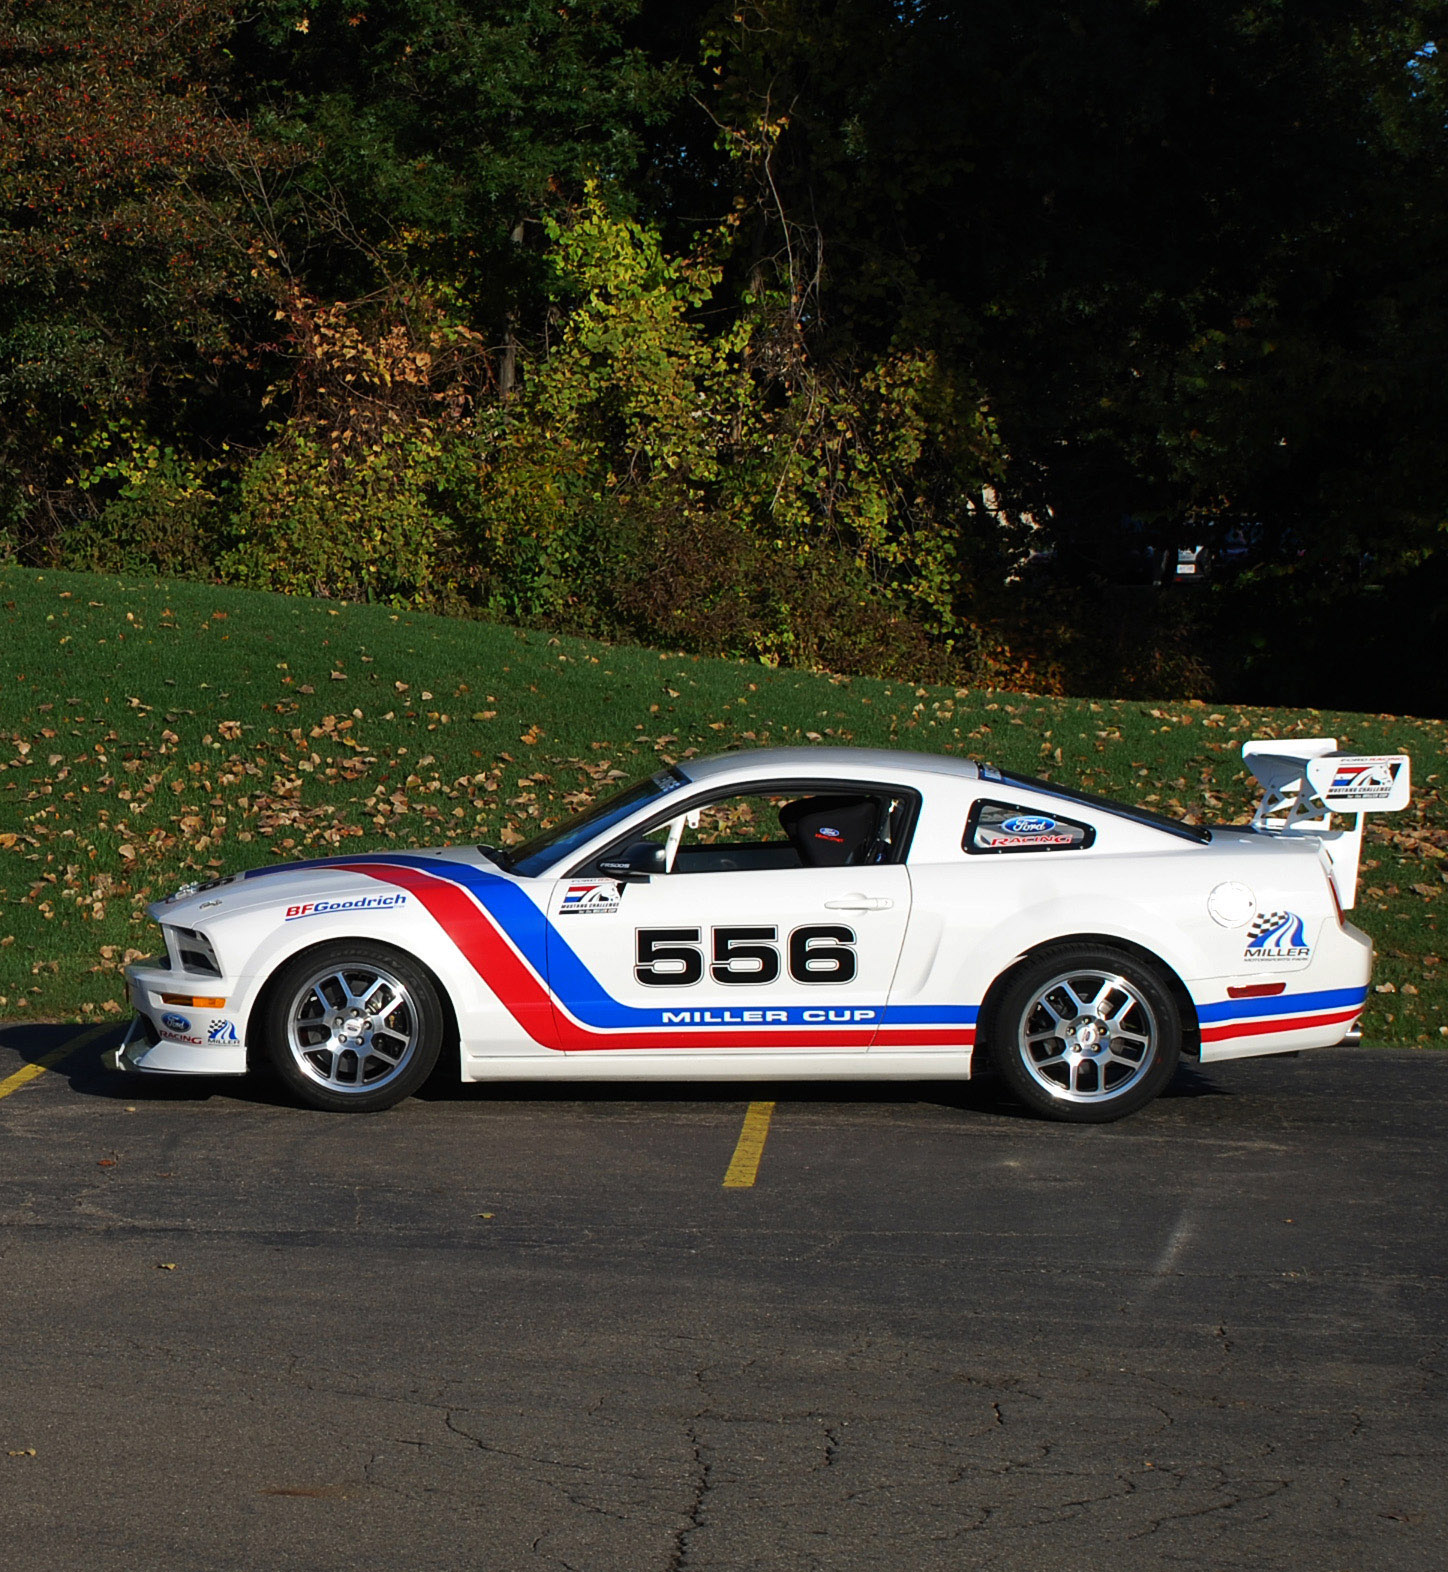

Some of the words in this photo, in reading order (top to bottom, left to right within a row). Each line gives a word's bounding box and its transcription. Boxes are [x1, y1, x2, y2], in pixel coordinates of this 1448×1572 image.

[1011, 817, 1047, 832] Ford
[991, 835, 1073, 846] RACING
[285, 894, 406, 917] BFGoodrich
[633, 923, 858, 988] 556
[1243, 948, 1311, 957] MILLER
[165, 1014, 187, 1030] Ford
[662, 1010, 788, 1023] MILLER
[802, 1009, 876, 1022] CUP
[159, 1029, 202, 1045] RACING
